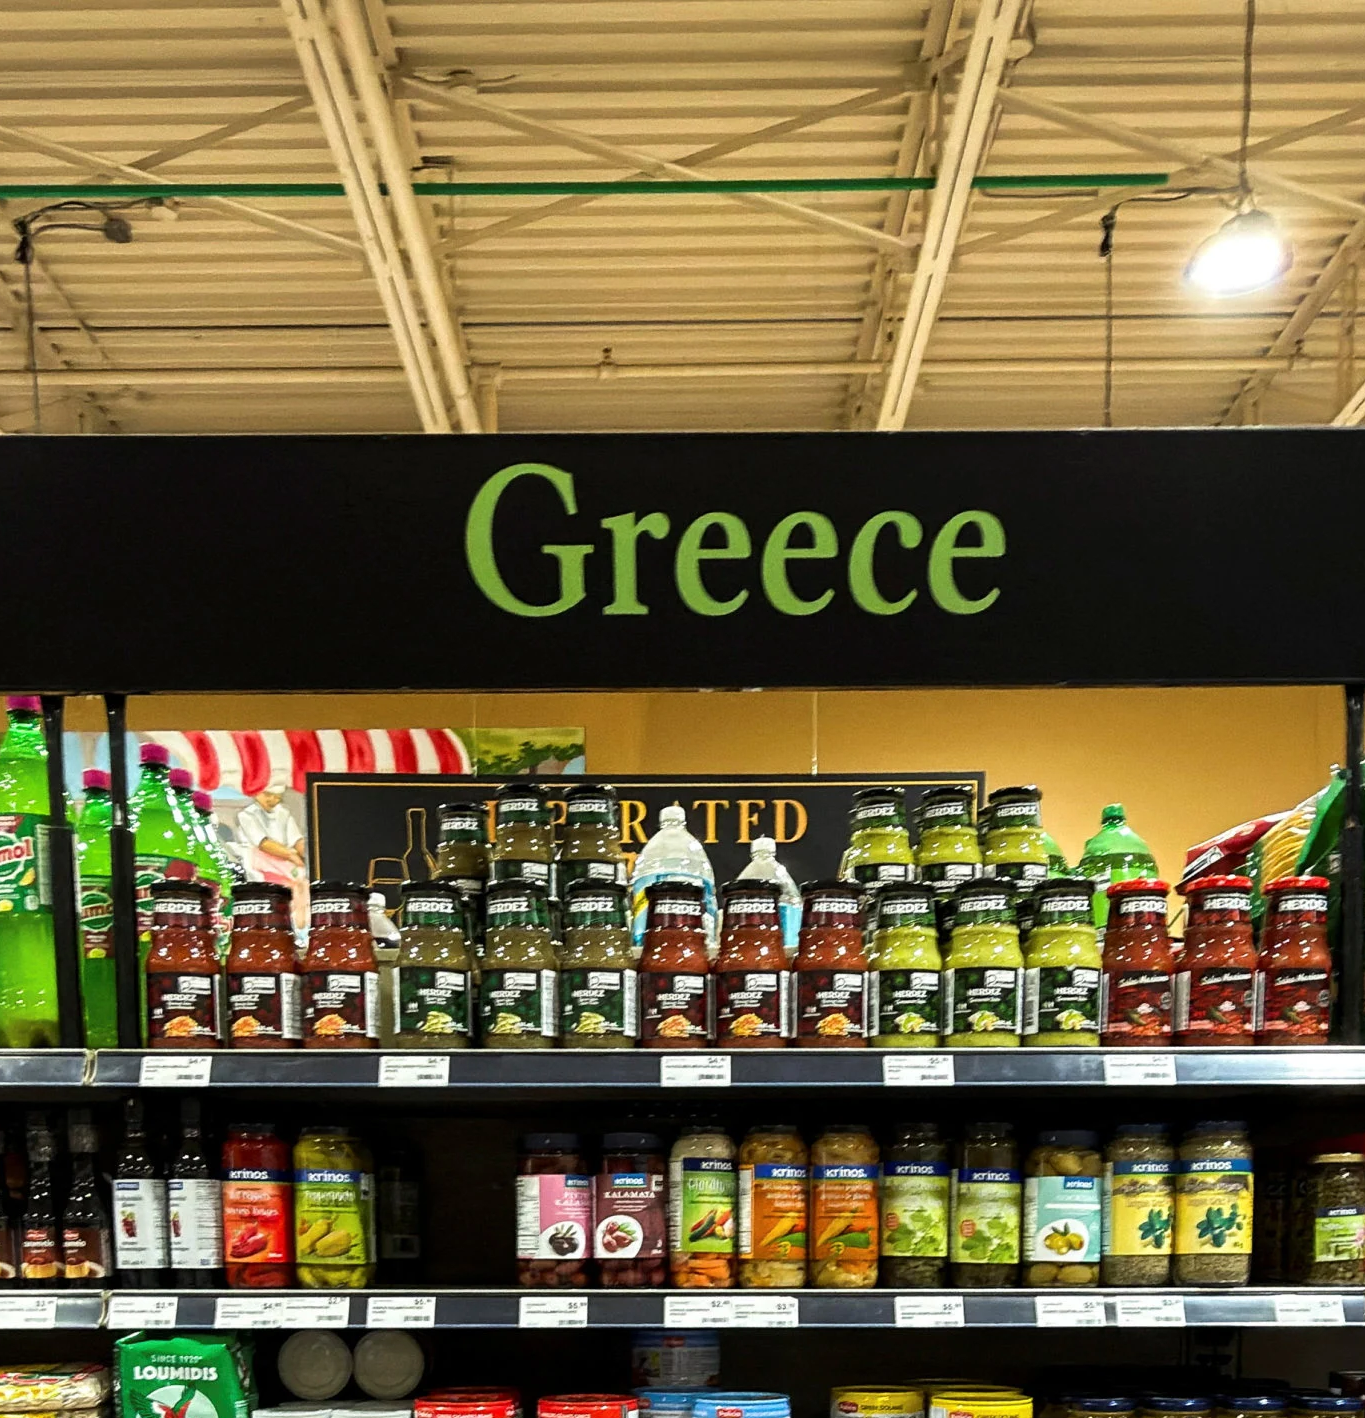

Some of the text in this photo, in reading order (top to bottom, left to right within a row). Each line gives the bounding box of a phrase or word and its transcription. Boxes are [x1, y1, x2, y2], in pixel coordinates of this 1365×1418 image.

[466, 463, 1006, 617] Greece
[655, 904, 702, 915] HERDEZ
[814, 902, 858, 913] HERDEZ
[308, 1172, 351, 1181] krinos
[604, 1191, 655, 1199] KALAMATA
[135, 1367, 218, 1381] LOUMIDIS
